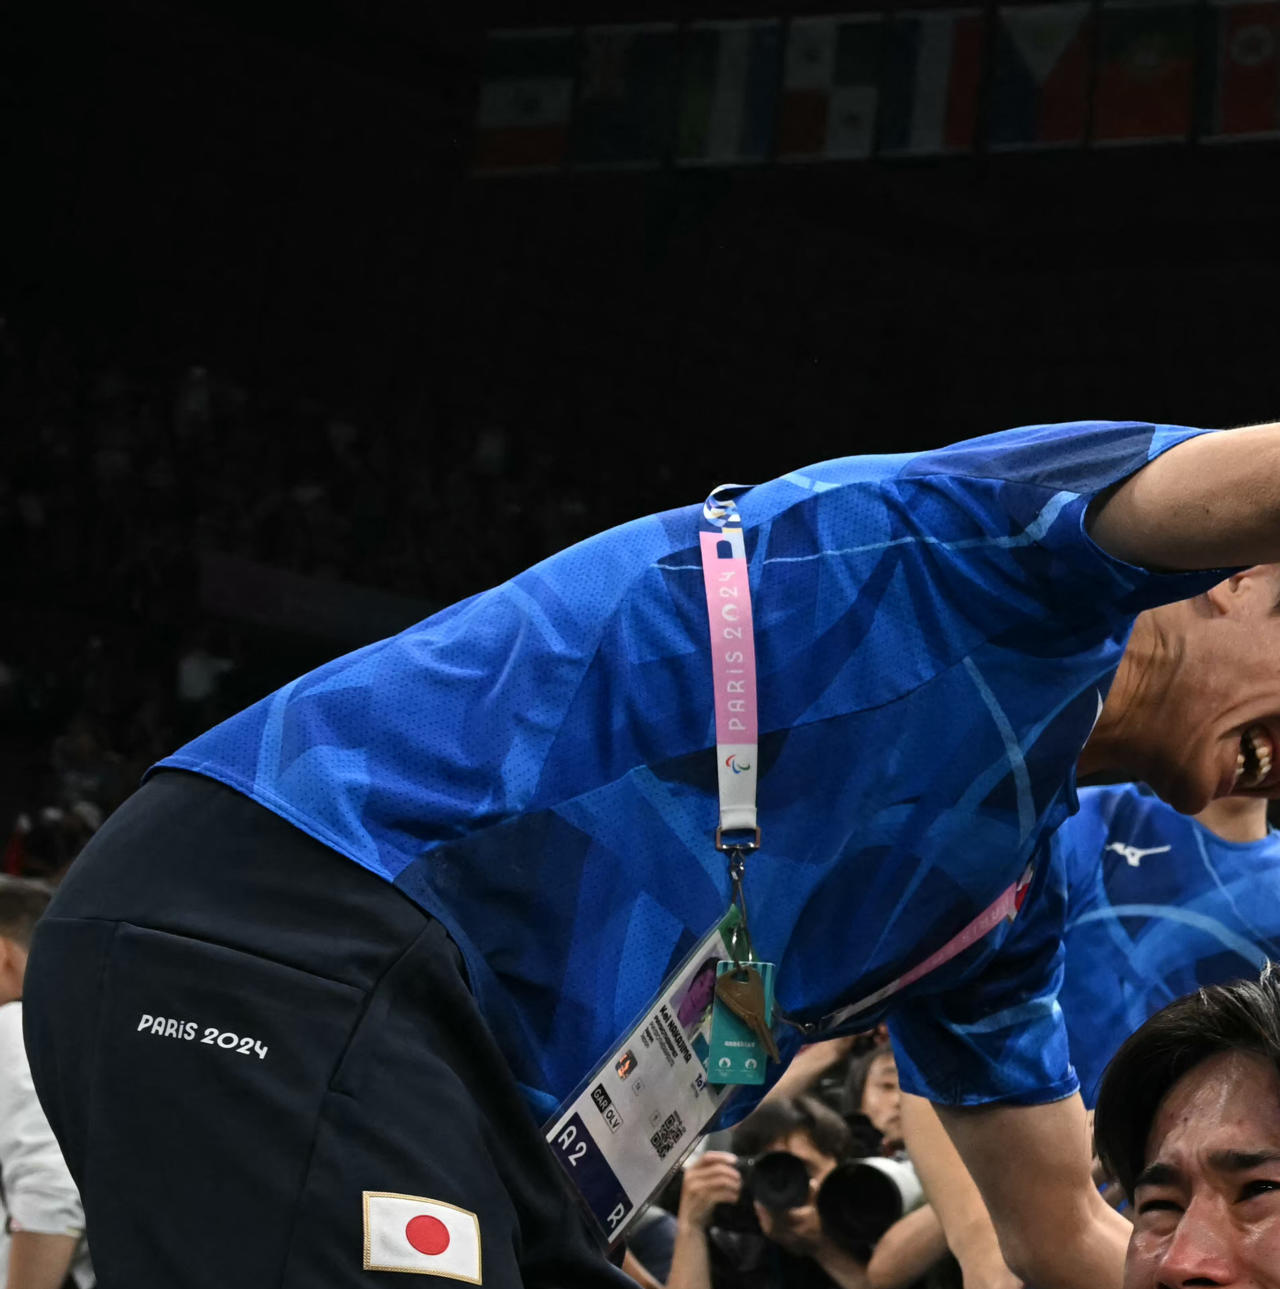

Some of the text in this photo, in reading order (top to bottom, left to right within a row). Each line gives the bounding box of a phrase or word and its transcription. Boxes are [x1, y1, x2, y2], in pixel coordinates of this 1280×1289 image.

[718, 571, 743, 639] 2024
[200, 1027, 269, 1060] 2024
[593, 1088, 621, 1130] GAR OLV
[607, 1203, 625, 1228] R
